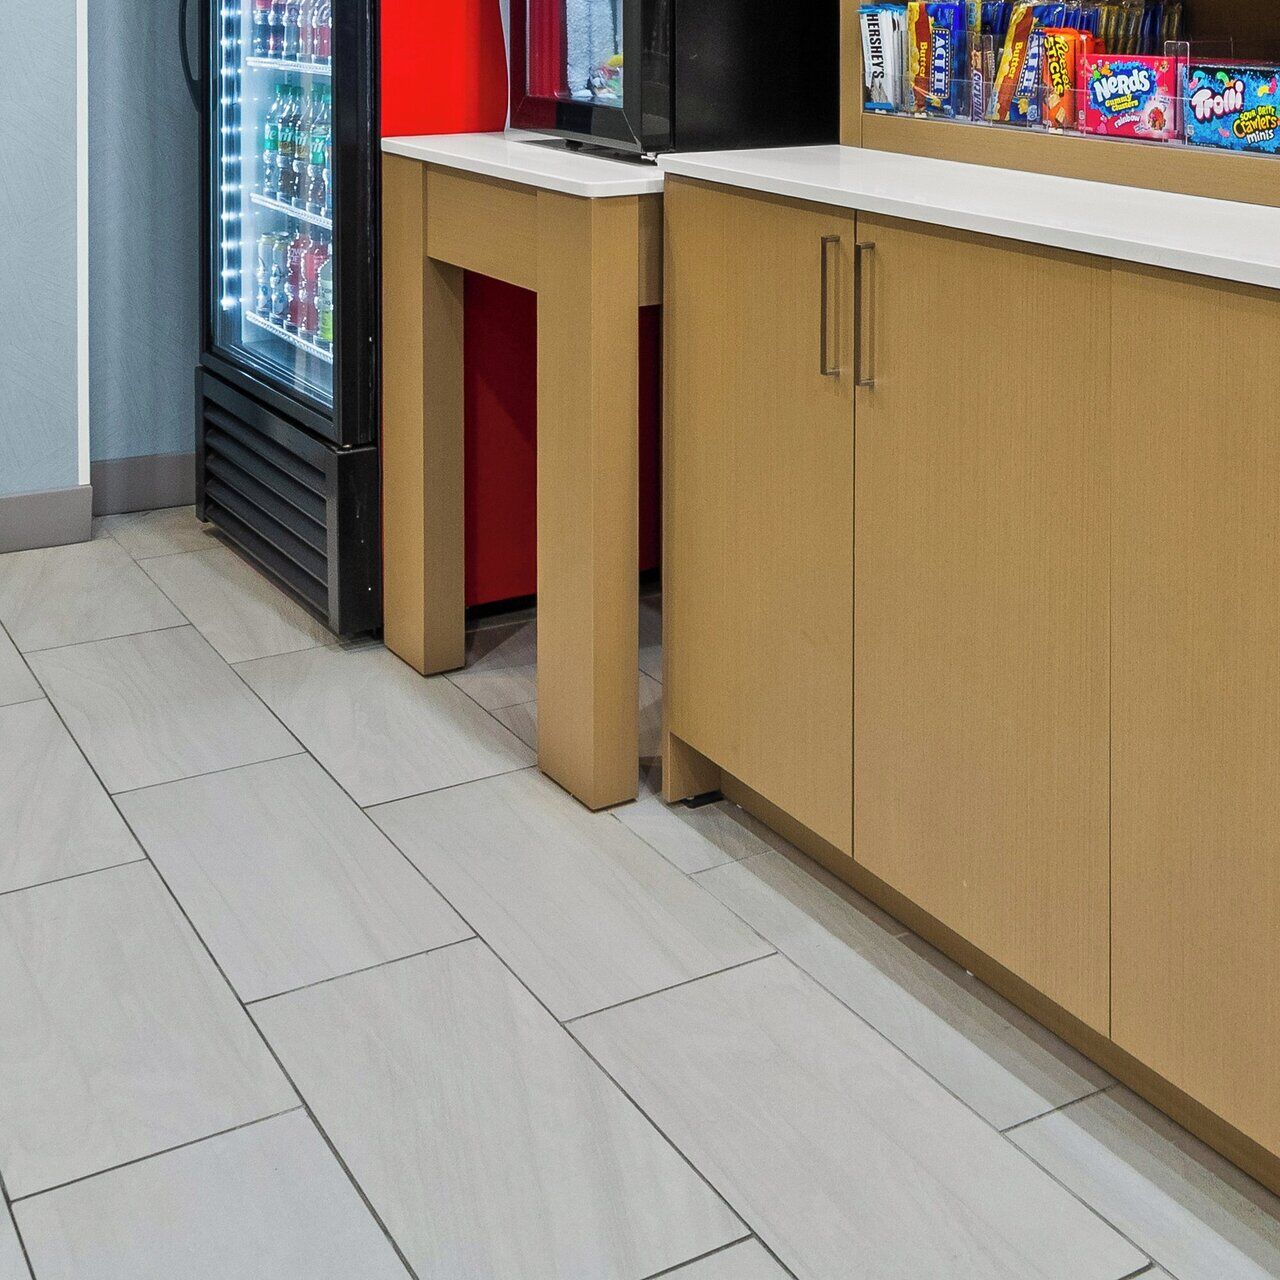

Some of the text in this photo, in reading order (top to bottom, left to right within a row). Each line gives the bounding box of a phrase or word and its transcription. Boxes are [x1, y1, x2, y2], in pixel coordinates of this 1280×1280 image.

[866, 13, 884, 79] HERSHEY'S
[919, 41, 928, 78] Butter
[934, 36, 946, 90] ACT II
[1009, 41, 1023, 79] Butter
[1192, 81, 1244, 120] Trolli
[1240, 108, 1256, 121] SOUR
[1233, 114, 1278, 138] Crawlers
[1247, 129, 1274, 144] minis
